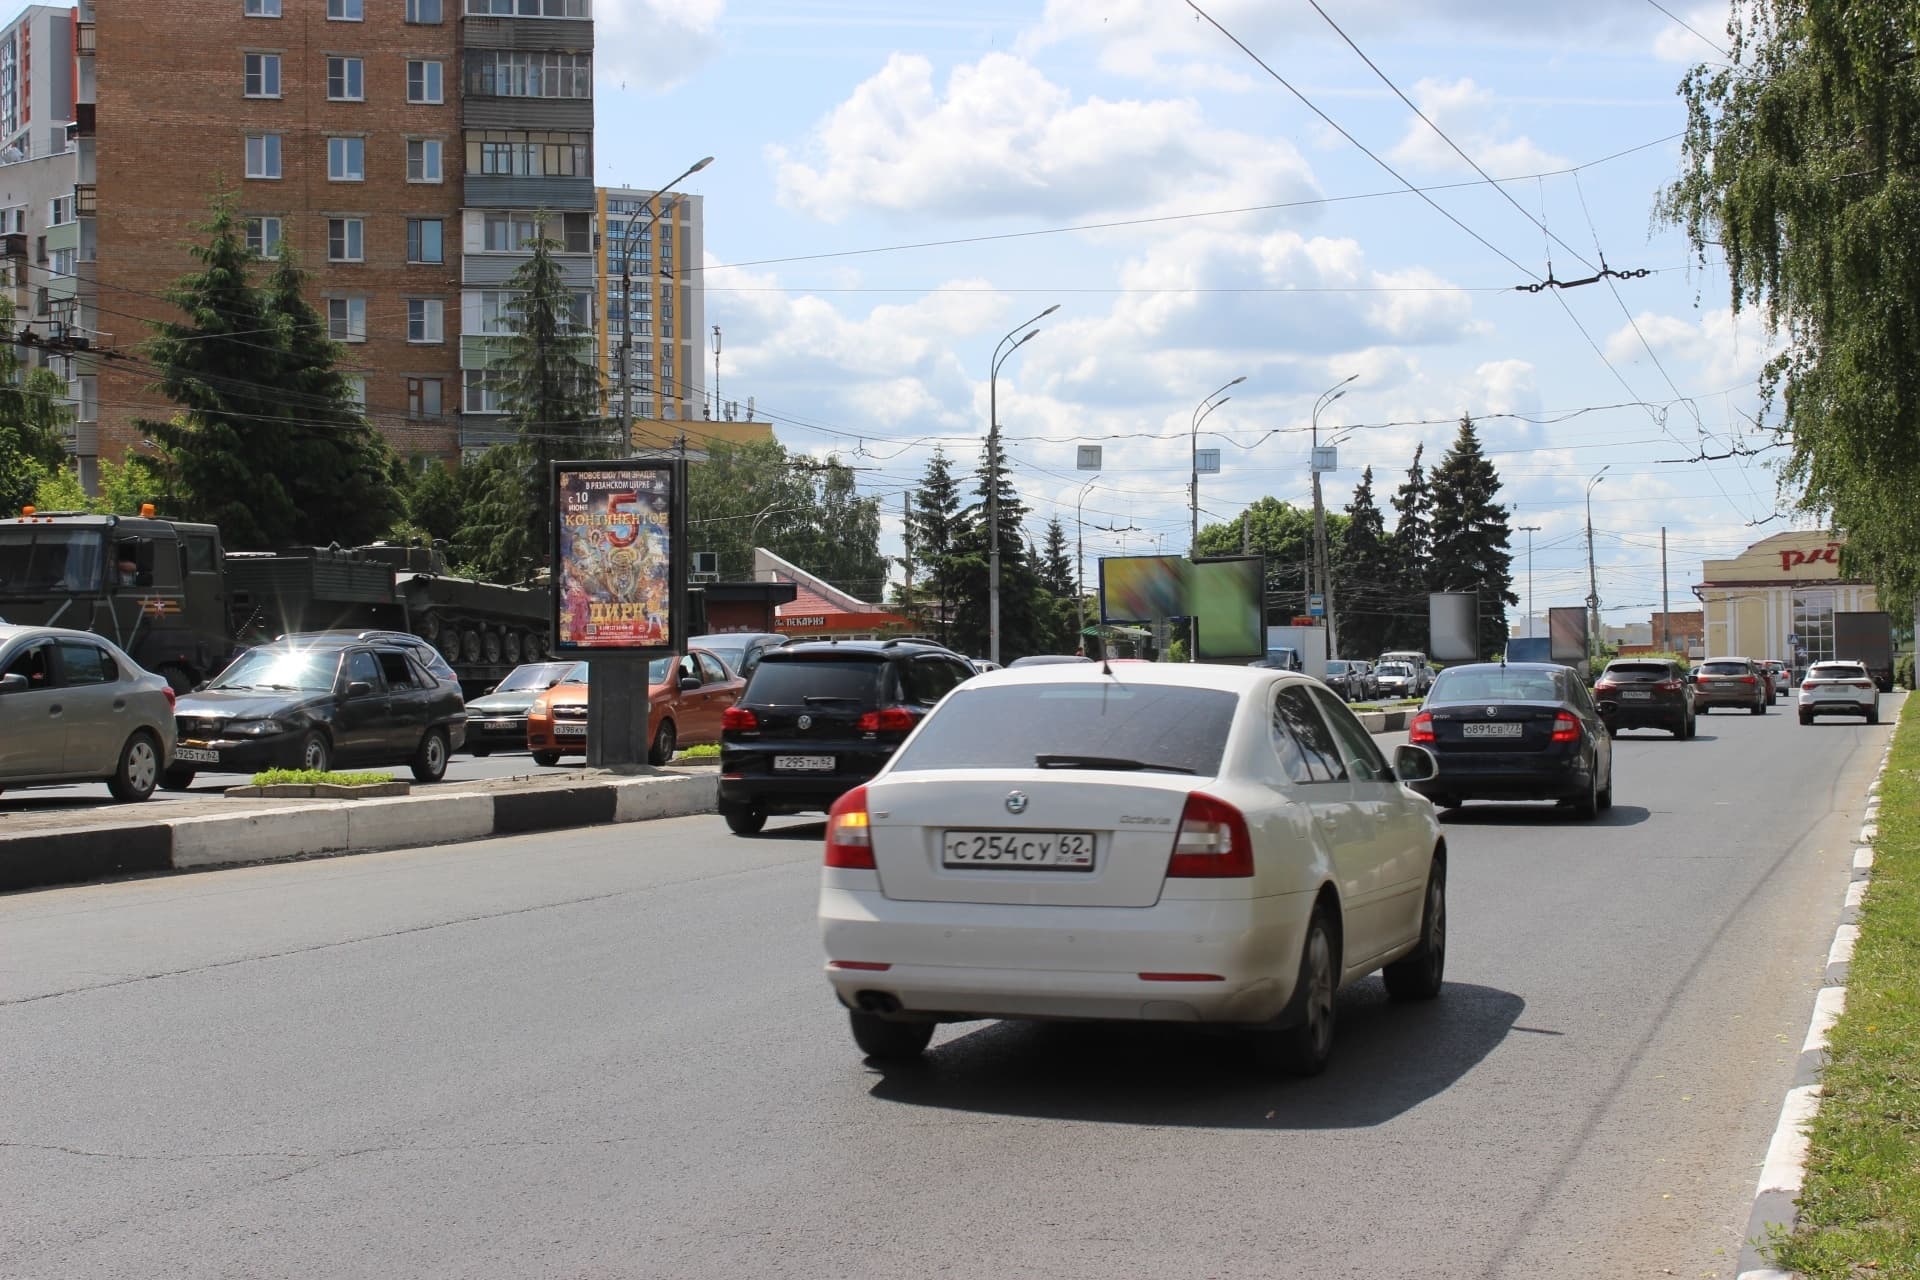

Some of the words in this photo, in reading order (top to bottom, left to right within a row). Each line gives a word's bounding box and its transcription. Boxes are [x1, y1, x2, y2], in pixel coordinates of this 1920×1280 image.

[579, 471, 601, 480] НОВОЕ
[602, 471, 617, 479] ШОУ
[585, 482, 590, 490] В
[590, 481, 629, 489] РЯЗАНСКОМ
[629, 480, 650, 489] ЦИРКЕ
[576, 492, 589, 503] 10
[568, 504, 589, 512] ИЮНЯ
[566, 512, 669, 526] КОНТИНЕНТОВ
[607, 491, 639, 548] 5
[589, 603, 646, 624] ЦИРК
[786, 617, 825, 627] ПЕКАРНЯ
[952, 836, 1052, 861] С254СУ
[1059, 836, 1084, 855] 62
